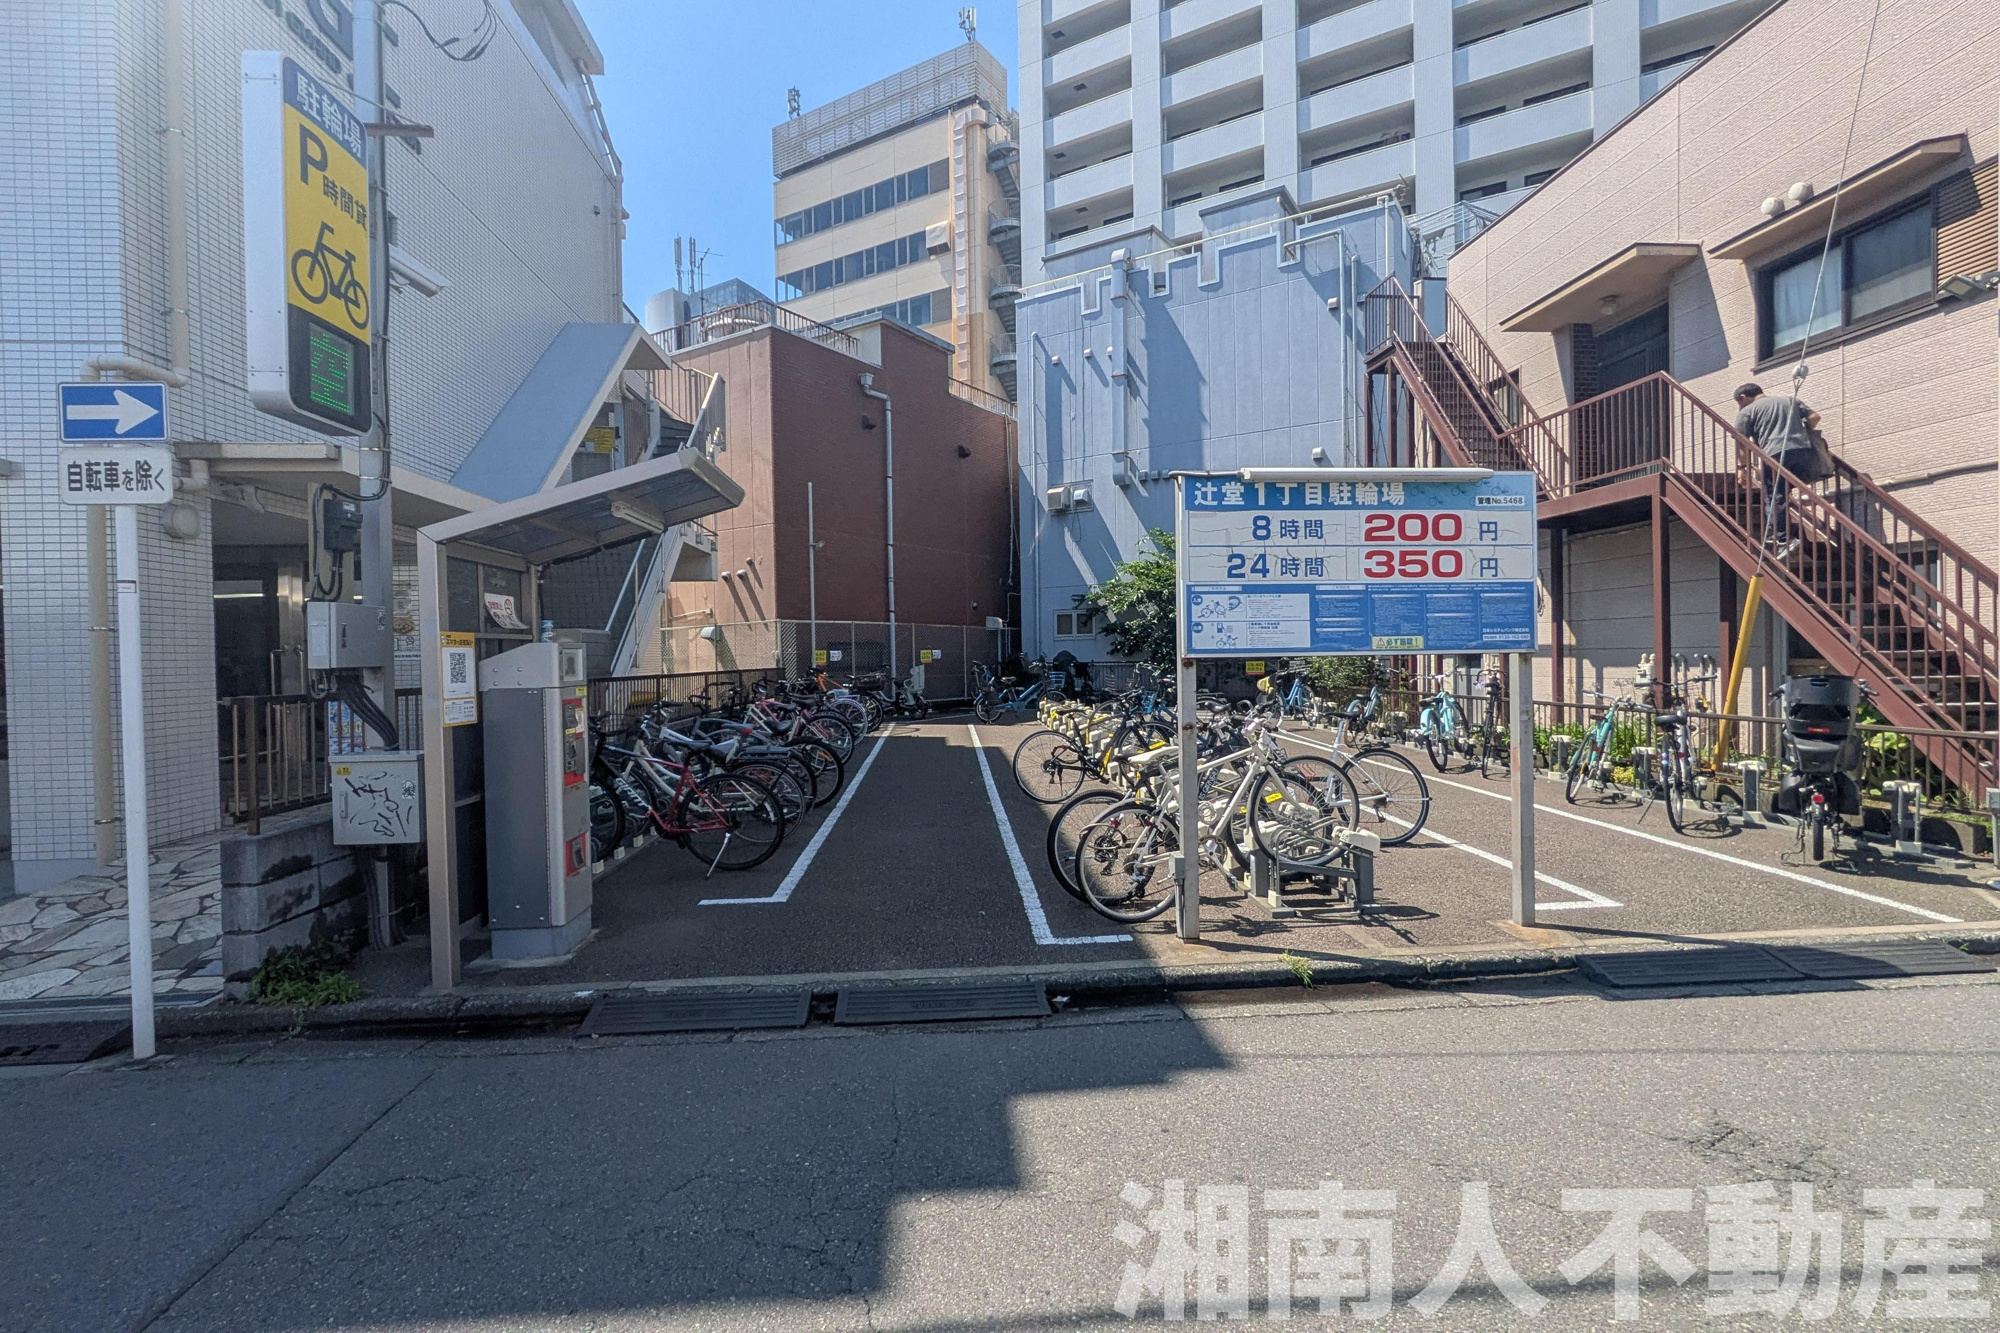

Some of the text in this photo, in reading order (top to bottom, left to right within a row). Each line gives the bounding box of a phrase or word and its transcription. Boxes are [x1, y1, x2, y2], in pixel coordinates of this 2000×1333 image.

[296, 72, 363, 159] 駐輪場
[299, 122, 329, 186] P
[322, 174, 368, 232] 時間貸
[67, 459, 165, 492] 自転車を除く
[614, 777, 649, 807] GIANT
